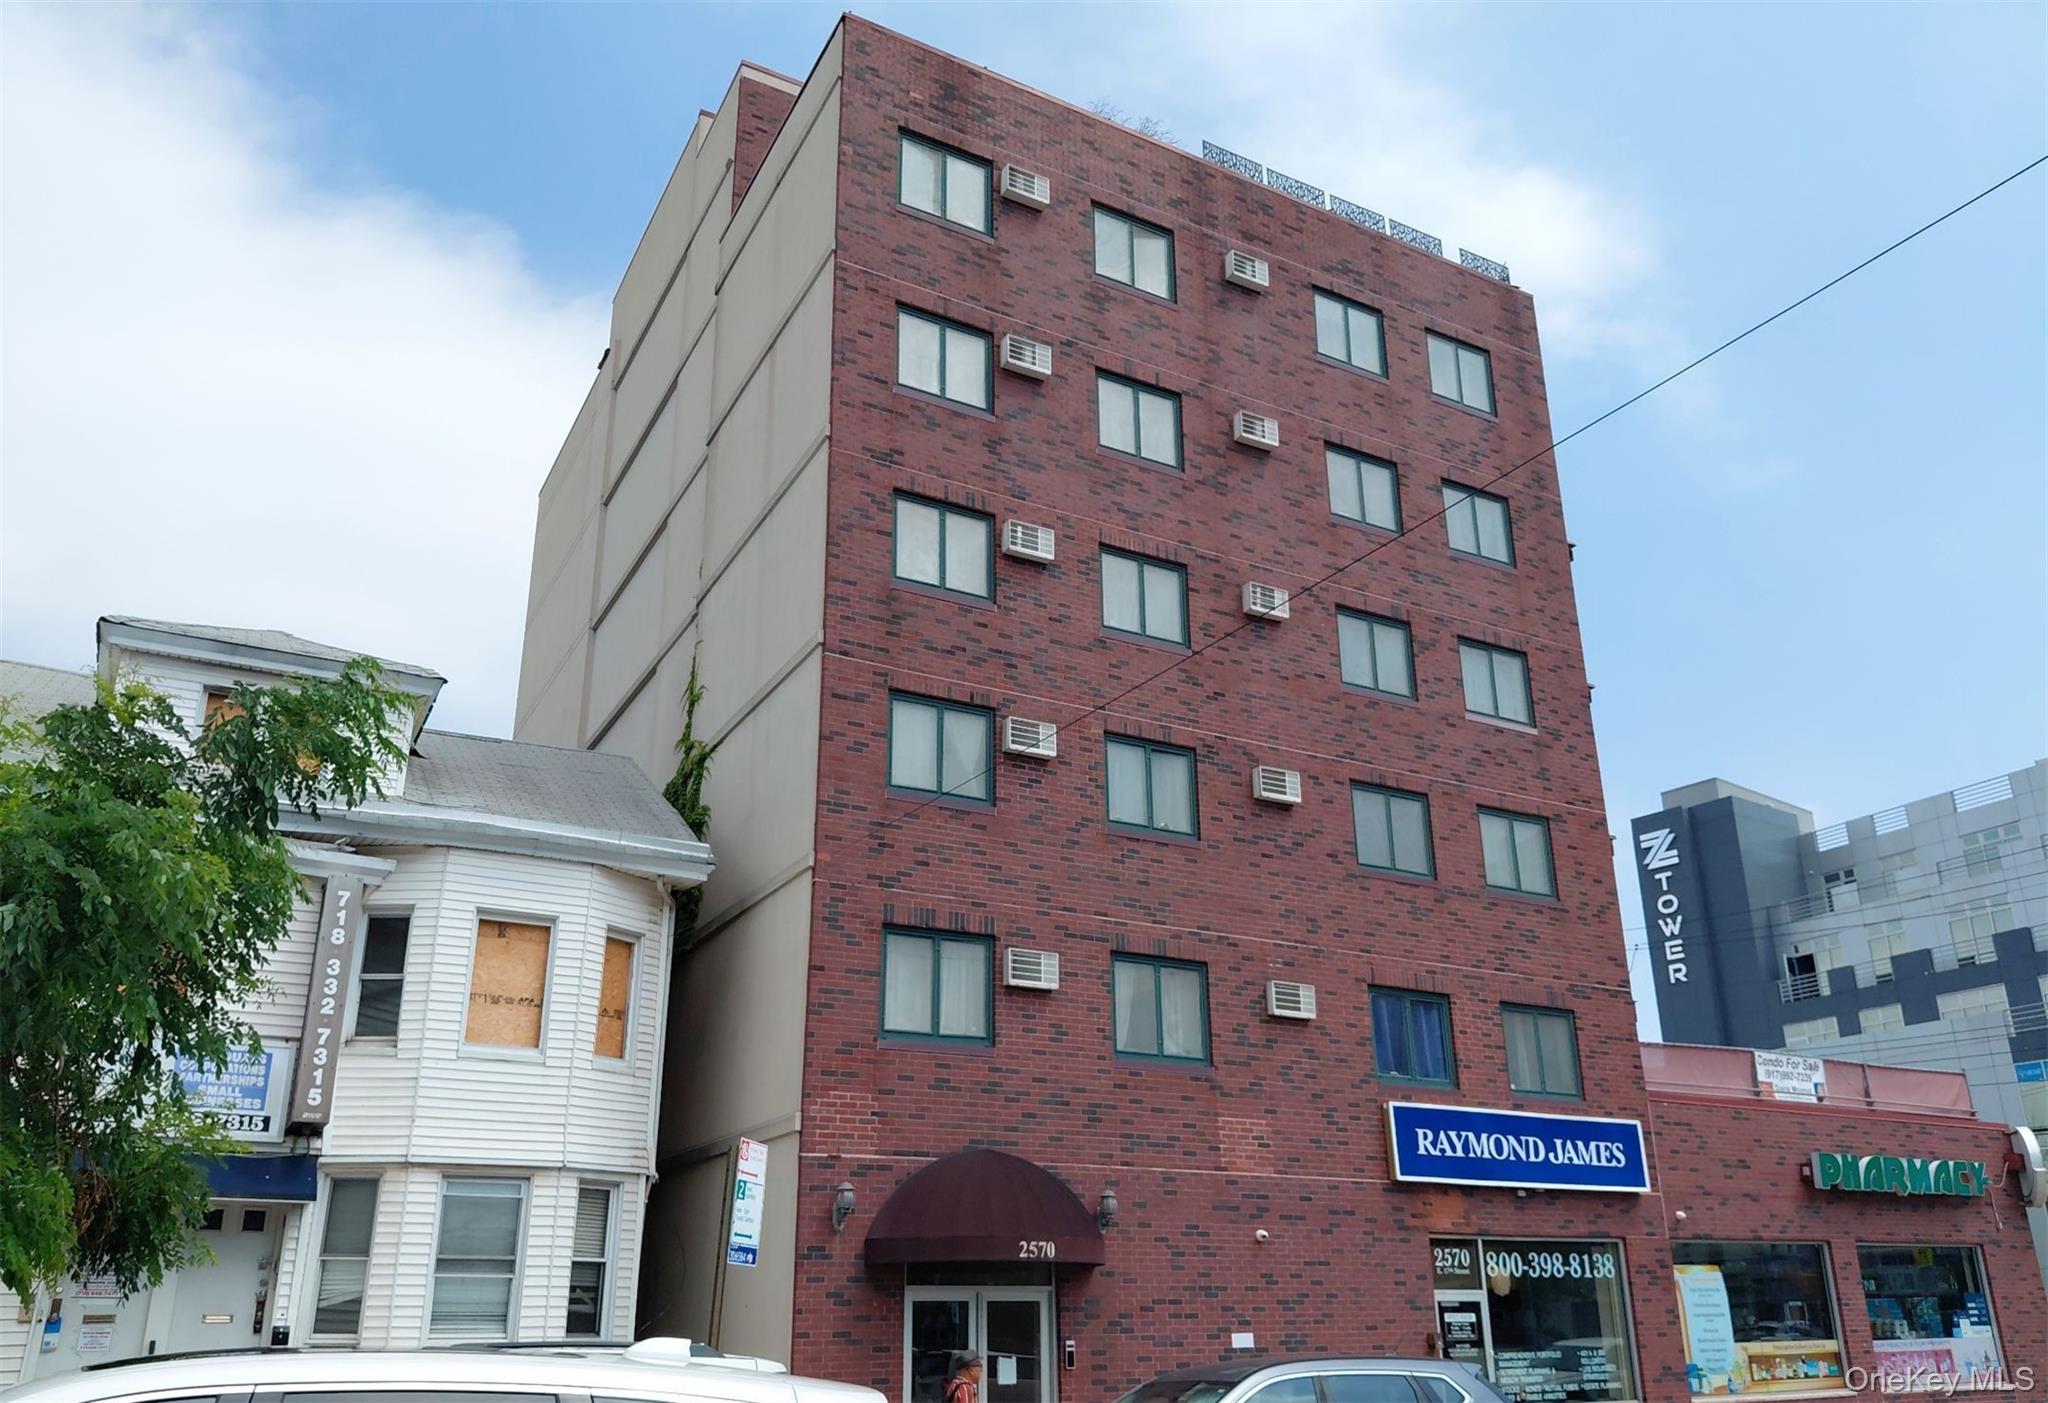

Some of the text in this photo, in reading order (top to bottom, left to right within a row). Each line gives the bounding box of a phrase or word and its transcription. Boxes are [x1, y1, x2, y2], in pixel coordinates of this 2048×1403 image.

[330, 890, 351, 945] 718
[1654, 871, 1689, 984] TOWER
[320, 958, 341, 1015] 332
[307, 1028, 331, 1106] 7315
[1757, 1054, 1820, 1072] Condo For Sale
[1415, 1128, 1627, 1168] RAYMOND JAMES
[1813, 1152, 1986, 1196] PHARMACY
[1018, 1240, 1056, 1258] 2570
[1434, 1248, 1471, 1267] 2570
[1486, 1251, 1616, 1279] 800-398-8138
